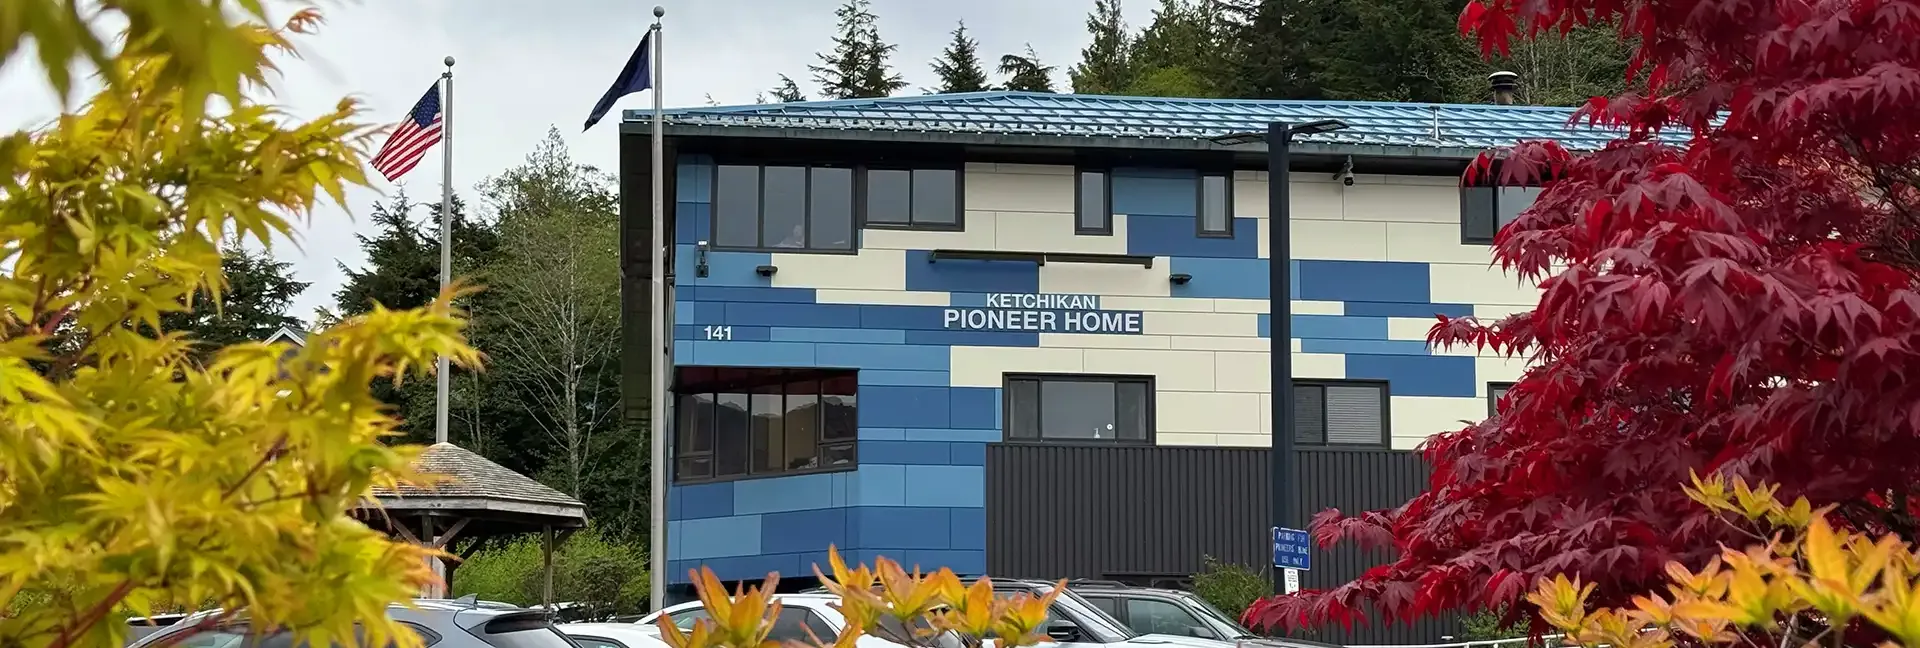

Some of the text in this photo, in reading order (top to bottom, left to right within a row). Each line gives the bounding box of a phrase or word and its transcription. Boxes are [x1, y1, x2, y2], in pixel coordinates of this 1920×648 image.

[986, 293, 1096, 310] KETCHIKAN
[943, 309, 1141, 333] PIONEER HOME
[703, 325, 732, 341] 141
